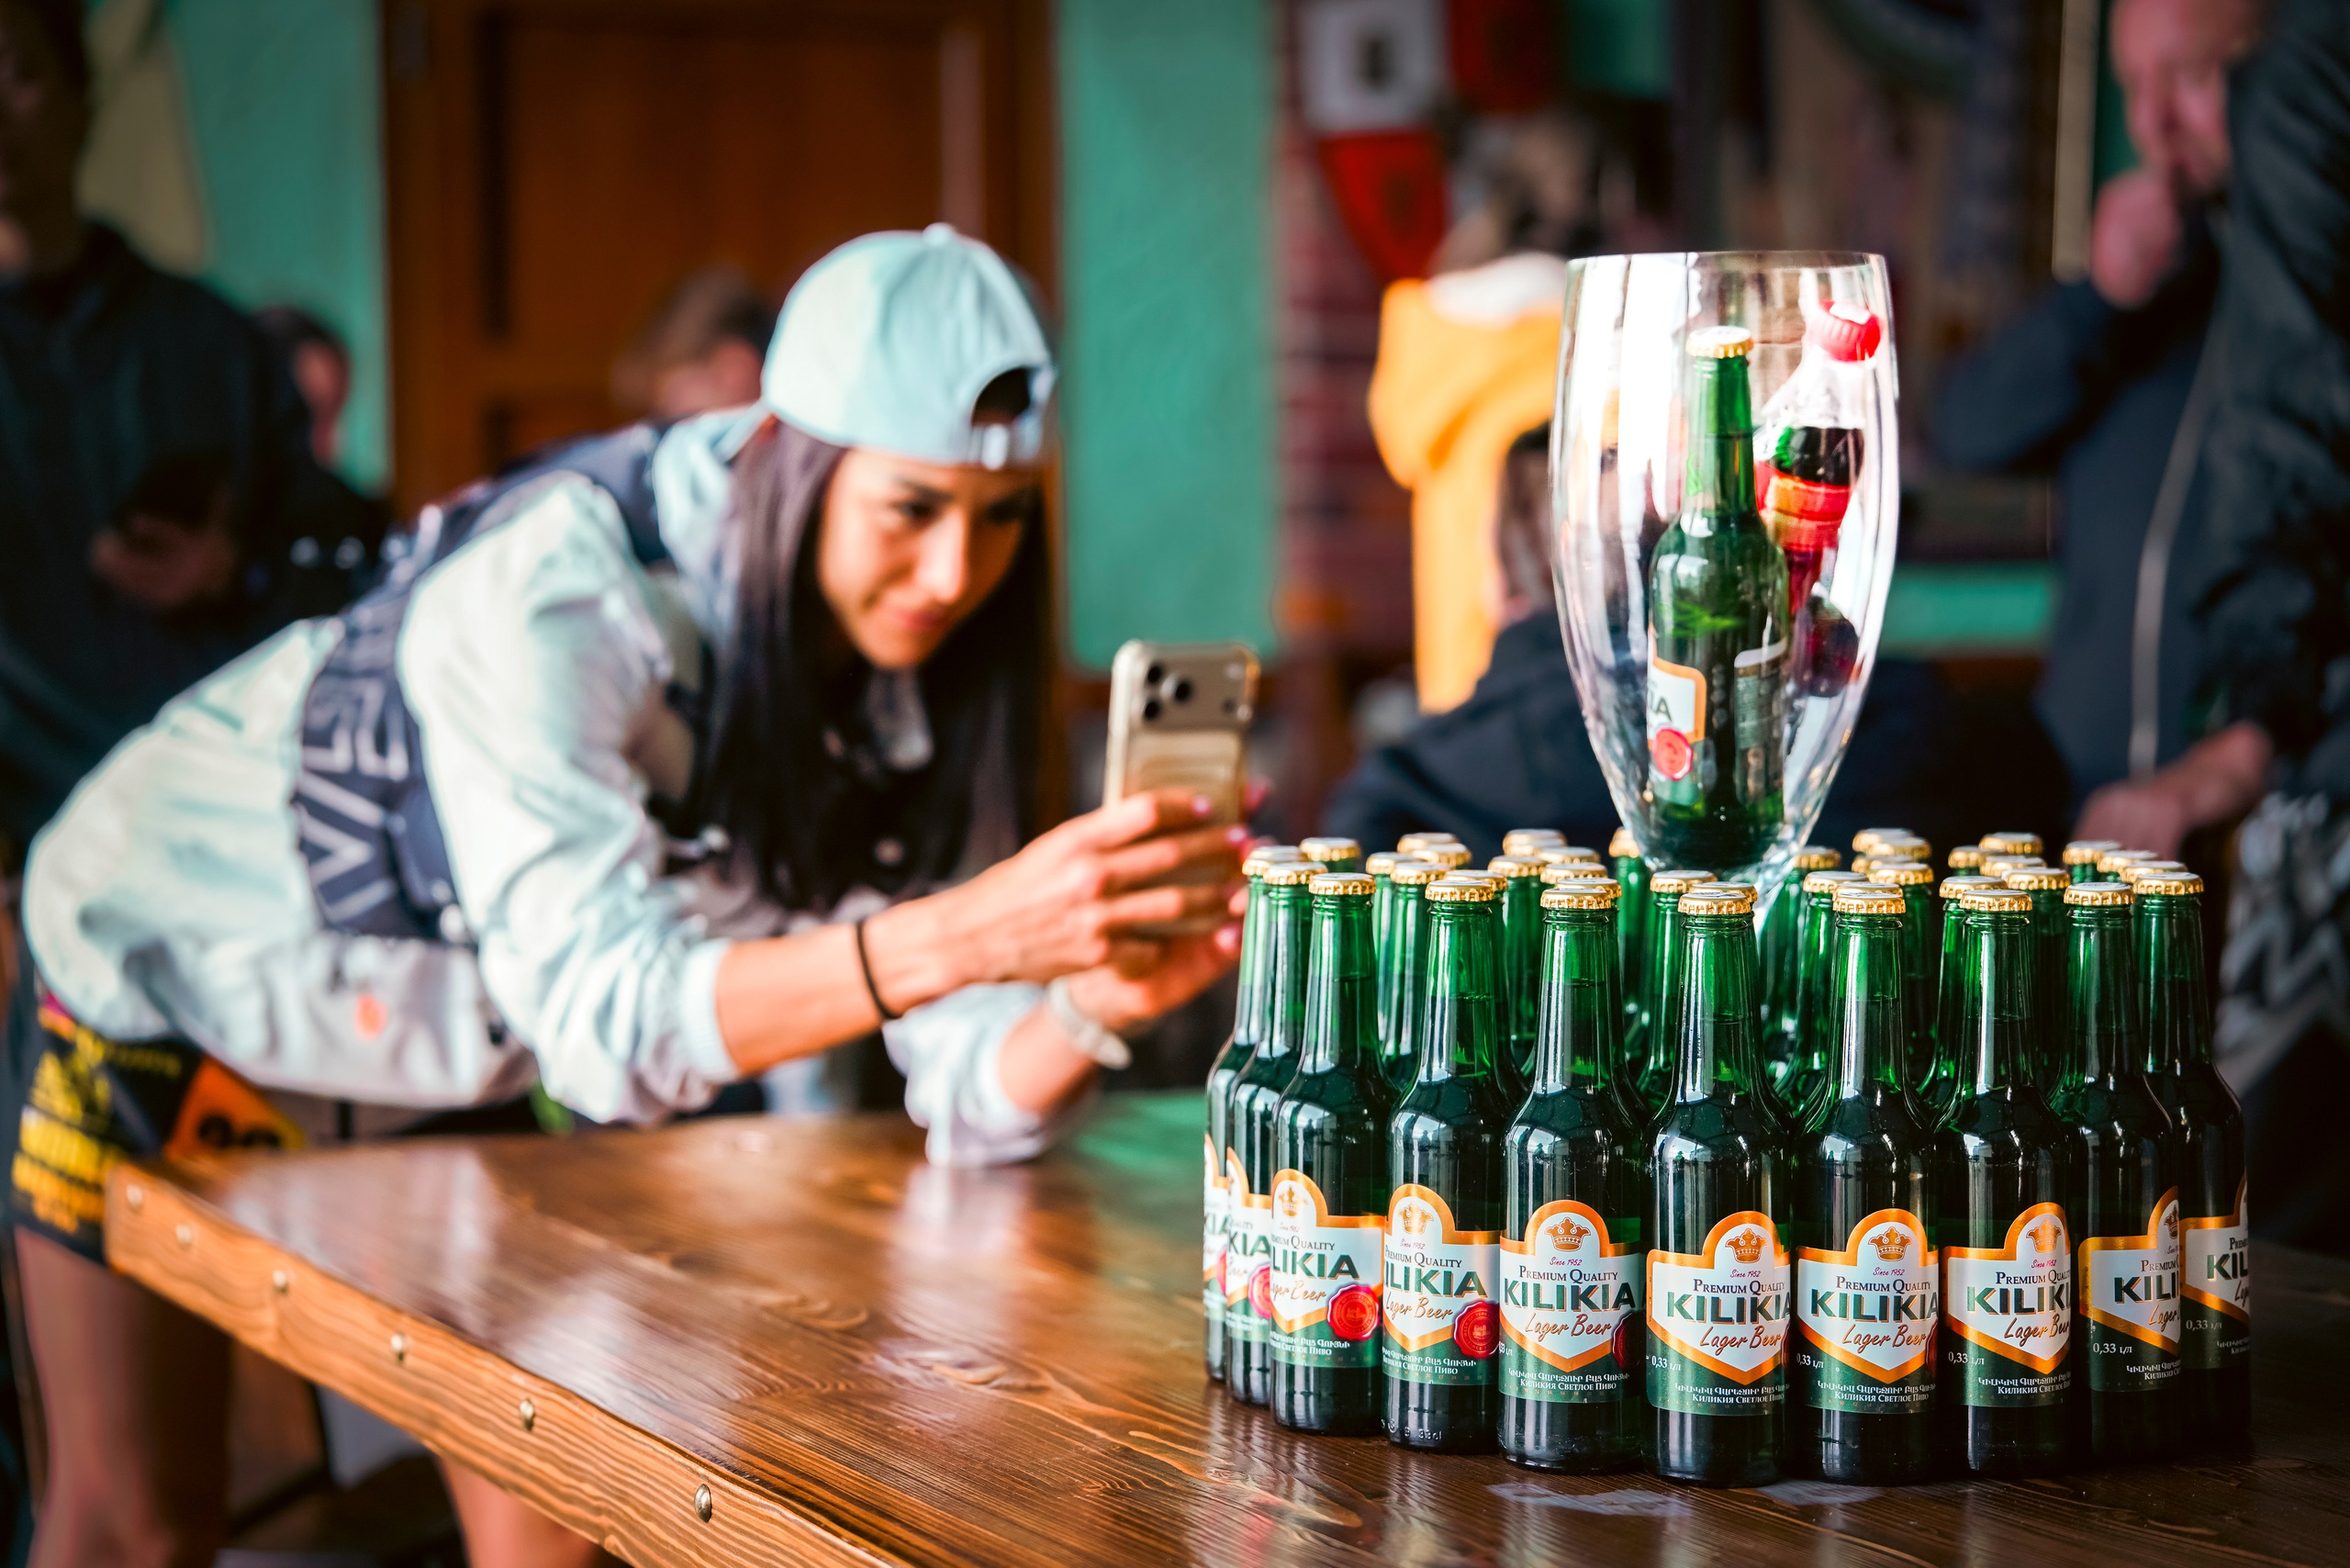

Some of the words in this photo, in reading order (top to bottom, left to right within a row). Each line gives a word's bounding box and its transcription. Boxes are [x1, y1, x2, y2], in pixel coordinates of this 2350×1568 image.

[1291, 1235, 1336, 1250] QUALITY
[1414, 1252, 1462, 1268] QUALITY
[1550, 1256, 1566, 1266] Since
[2031, 1259, 2045, 1269] Since
[2141, 1260, 2176, 1272] PREMIUM
[1519, 1265, 1567, 1282] PREMIUM
[1569, 1269, 1618, 1284] QUALITY
[1729, 1268, 1746, 1278] Since
[1747, 1270, 1761, 1278] 1952
[1873, 1267, 1889, 1276] Since
[1890, 1268, 1906, 1276] 1952
[1996, 1271, 2046, 1284] PREMIUM
[1291, 1280, 1327, 1302] Beer
[1693, 1278, 1747, 1294] PREMIUM
[1750, 1280, 1785, 1295] QUALITY
[1836, 1276, 1890, 1292] PREMIUM
[1892, 1279, 1930, 1294] QUALITY
[1504, 1278, 1637, 1312] KILIKIA
[1414, 1296, 1453, 1320] Beer
[1811, 1288, 1939, 1323] KILIKIA
[2149, 1305, 2177, 1332] Lager
[2186, 1319, 2209, 1331] 0,33
[1525, 1313, 1570, 1342] Lager
[1571, 1313, 1612, 1337] Beer
[2004, 1317, 2048, 1348] Lager
[1700, 1326, 1748, 1356] Lager
[1749, 1325, 1782, 1350] Beer
[1841, 1324, 1891, 1354] Lager
[1892, 1323, 1927, 1348] Beer
[2093, 1343, 2116, 1354] 0,33
[1651, 1355, 1668, 1368] 0,33
[1796, 1353, 1811, 1366] 0,33
[1948, 1351, 1968, 1364] 0,33
[1434, 1365, 1459, 1374] ПИВО
[1520, 1378, 1556, 1390] КИЛИКИЯ
[1558, 1382, 1595, 1391] СВЕТЛОЕ
[1595, 1383, 1617, 1391] ПИВО
[1998, 1385, 2038, 1394] КИЛИКИЯ
[1692, 1394, 1734, 1404] КИЛИКИЯ
[1735, 1394, 1769, 1404] СВЕТЛОЕ
[1834, 1391, 1876, 1402] КИЛИКИЯ
[1877, 1394, 1912, 1403] СВЕТЛОЕ
